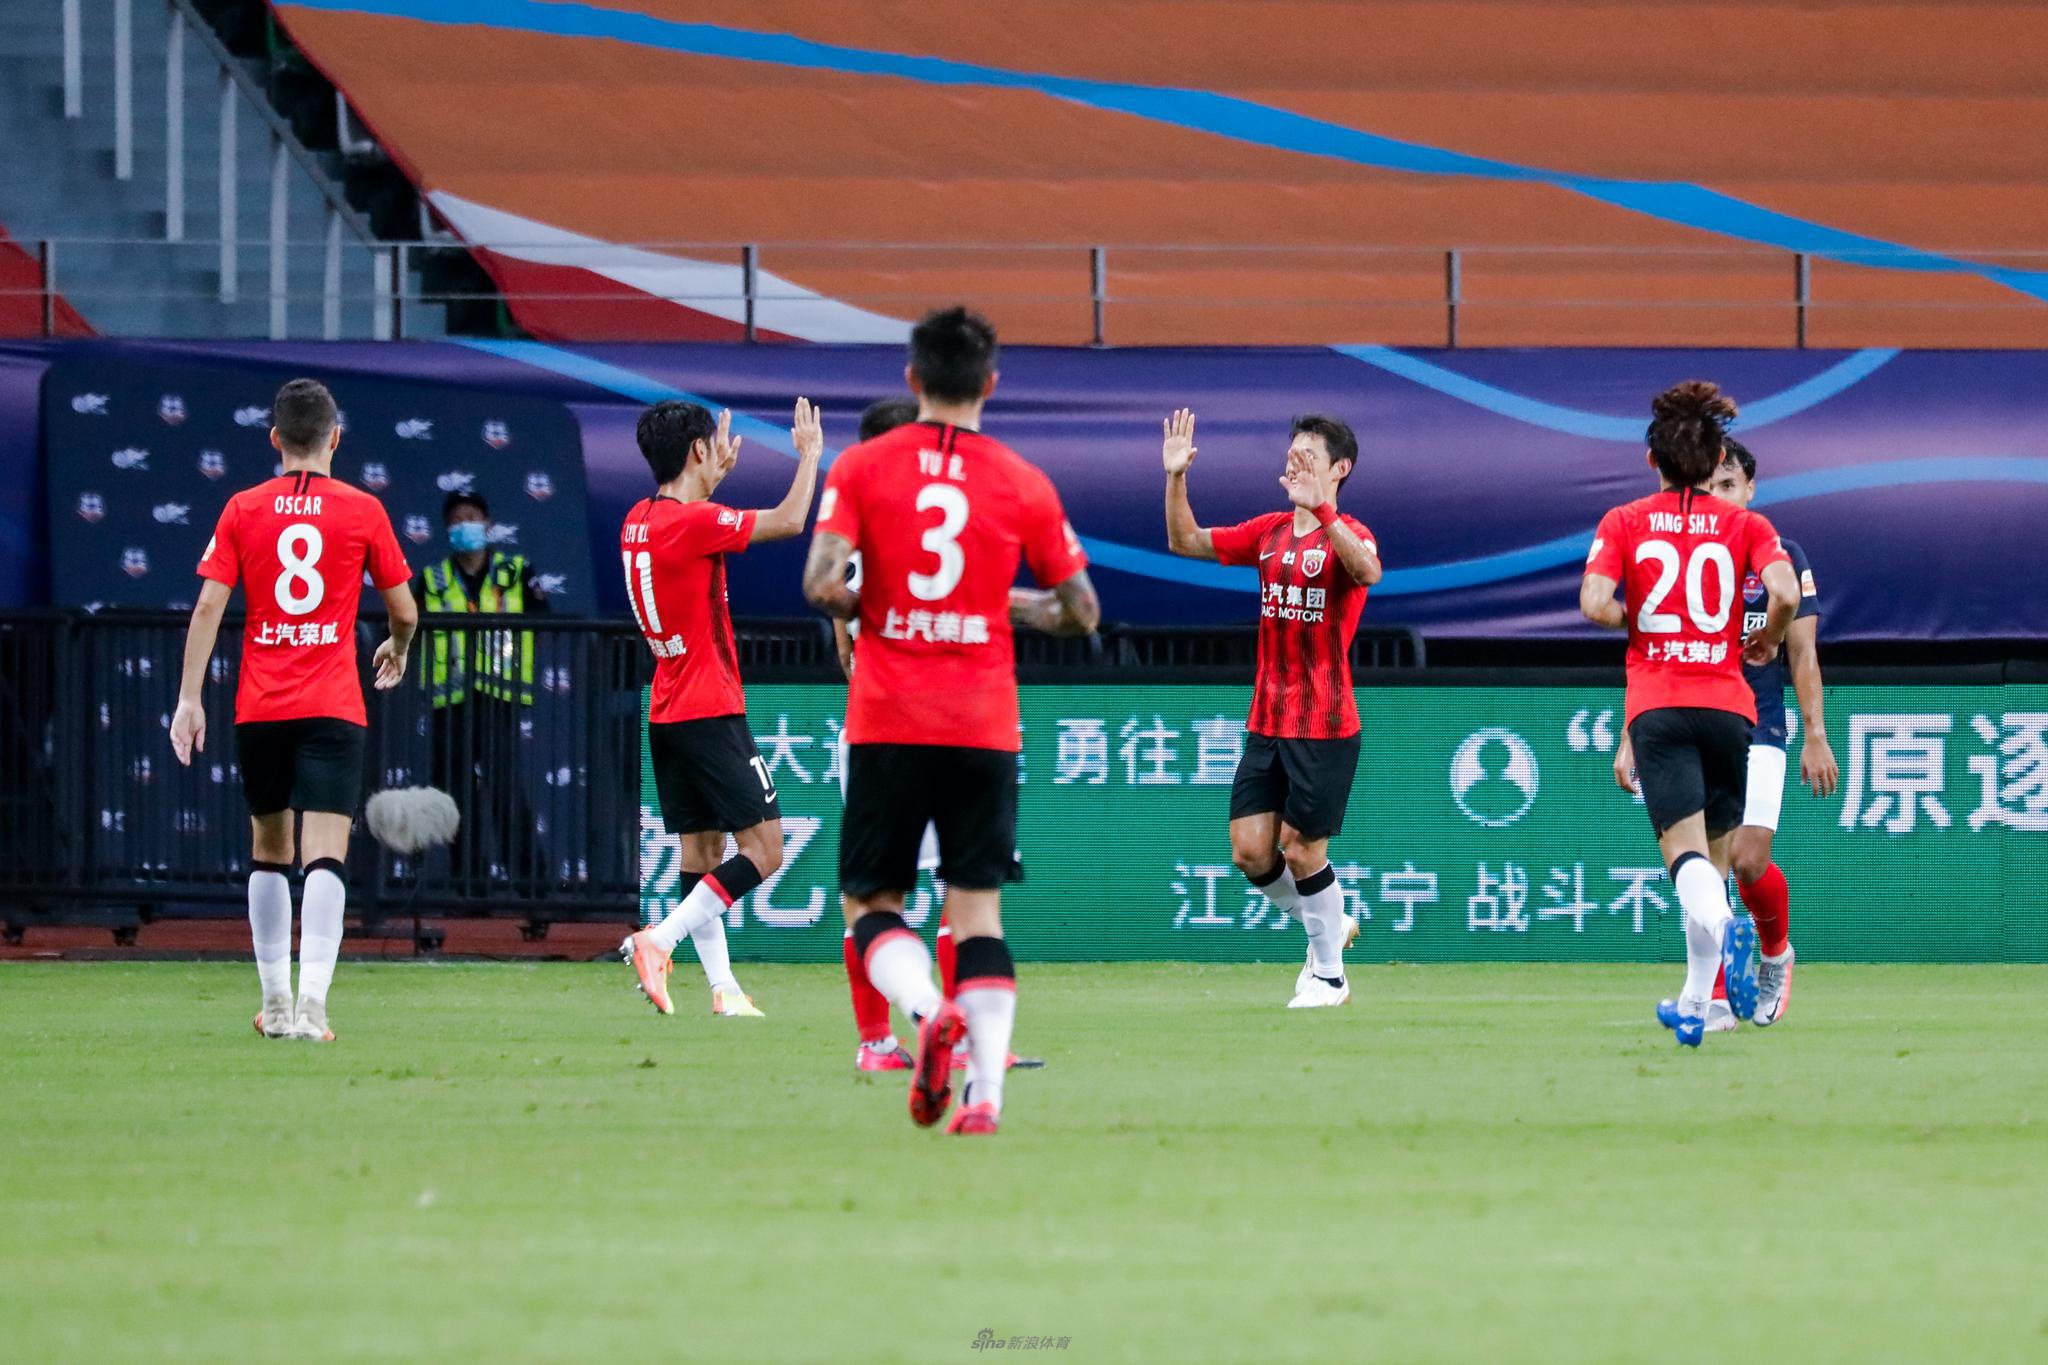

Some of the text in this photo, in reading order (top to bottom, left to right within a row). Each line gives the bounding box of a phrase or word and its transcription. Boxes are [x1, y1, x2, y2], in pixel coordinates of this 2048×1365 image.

[918, 448, 943, 477] YU
[274, 495, 323, 515] OSCAR
[1649, 512, 1720, 535] YANG SH.Y.
[907, 483, 969, 601] 3
[274, 523, 324, 615] 8
[622, 550, 663, 633] 11
[1635, 540, 1735, 633] 20
[880, 607, 989, 644] 上汽荣威
[1278, 607, 1324, 622] MOTOR
[254, 621, 339, 646] 上汽荣威
[646, 633, 687, 659] 荣威
[1647, 640, 1728, 664] 上汽荣威
[1468, 861, 1740, 933] 战斗不
